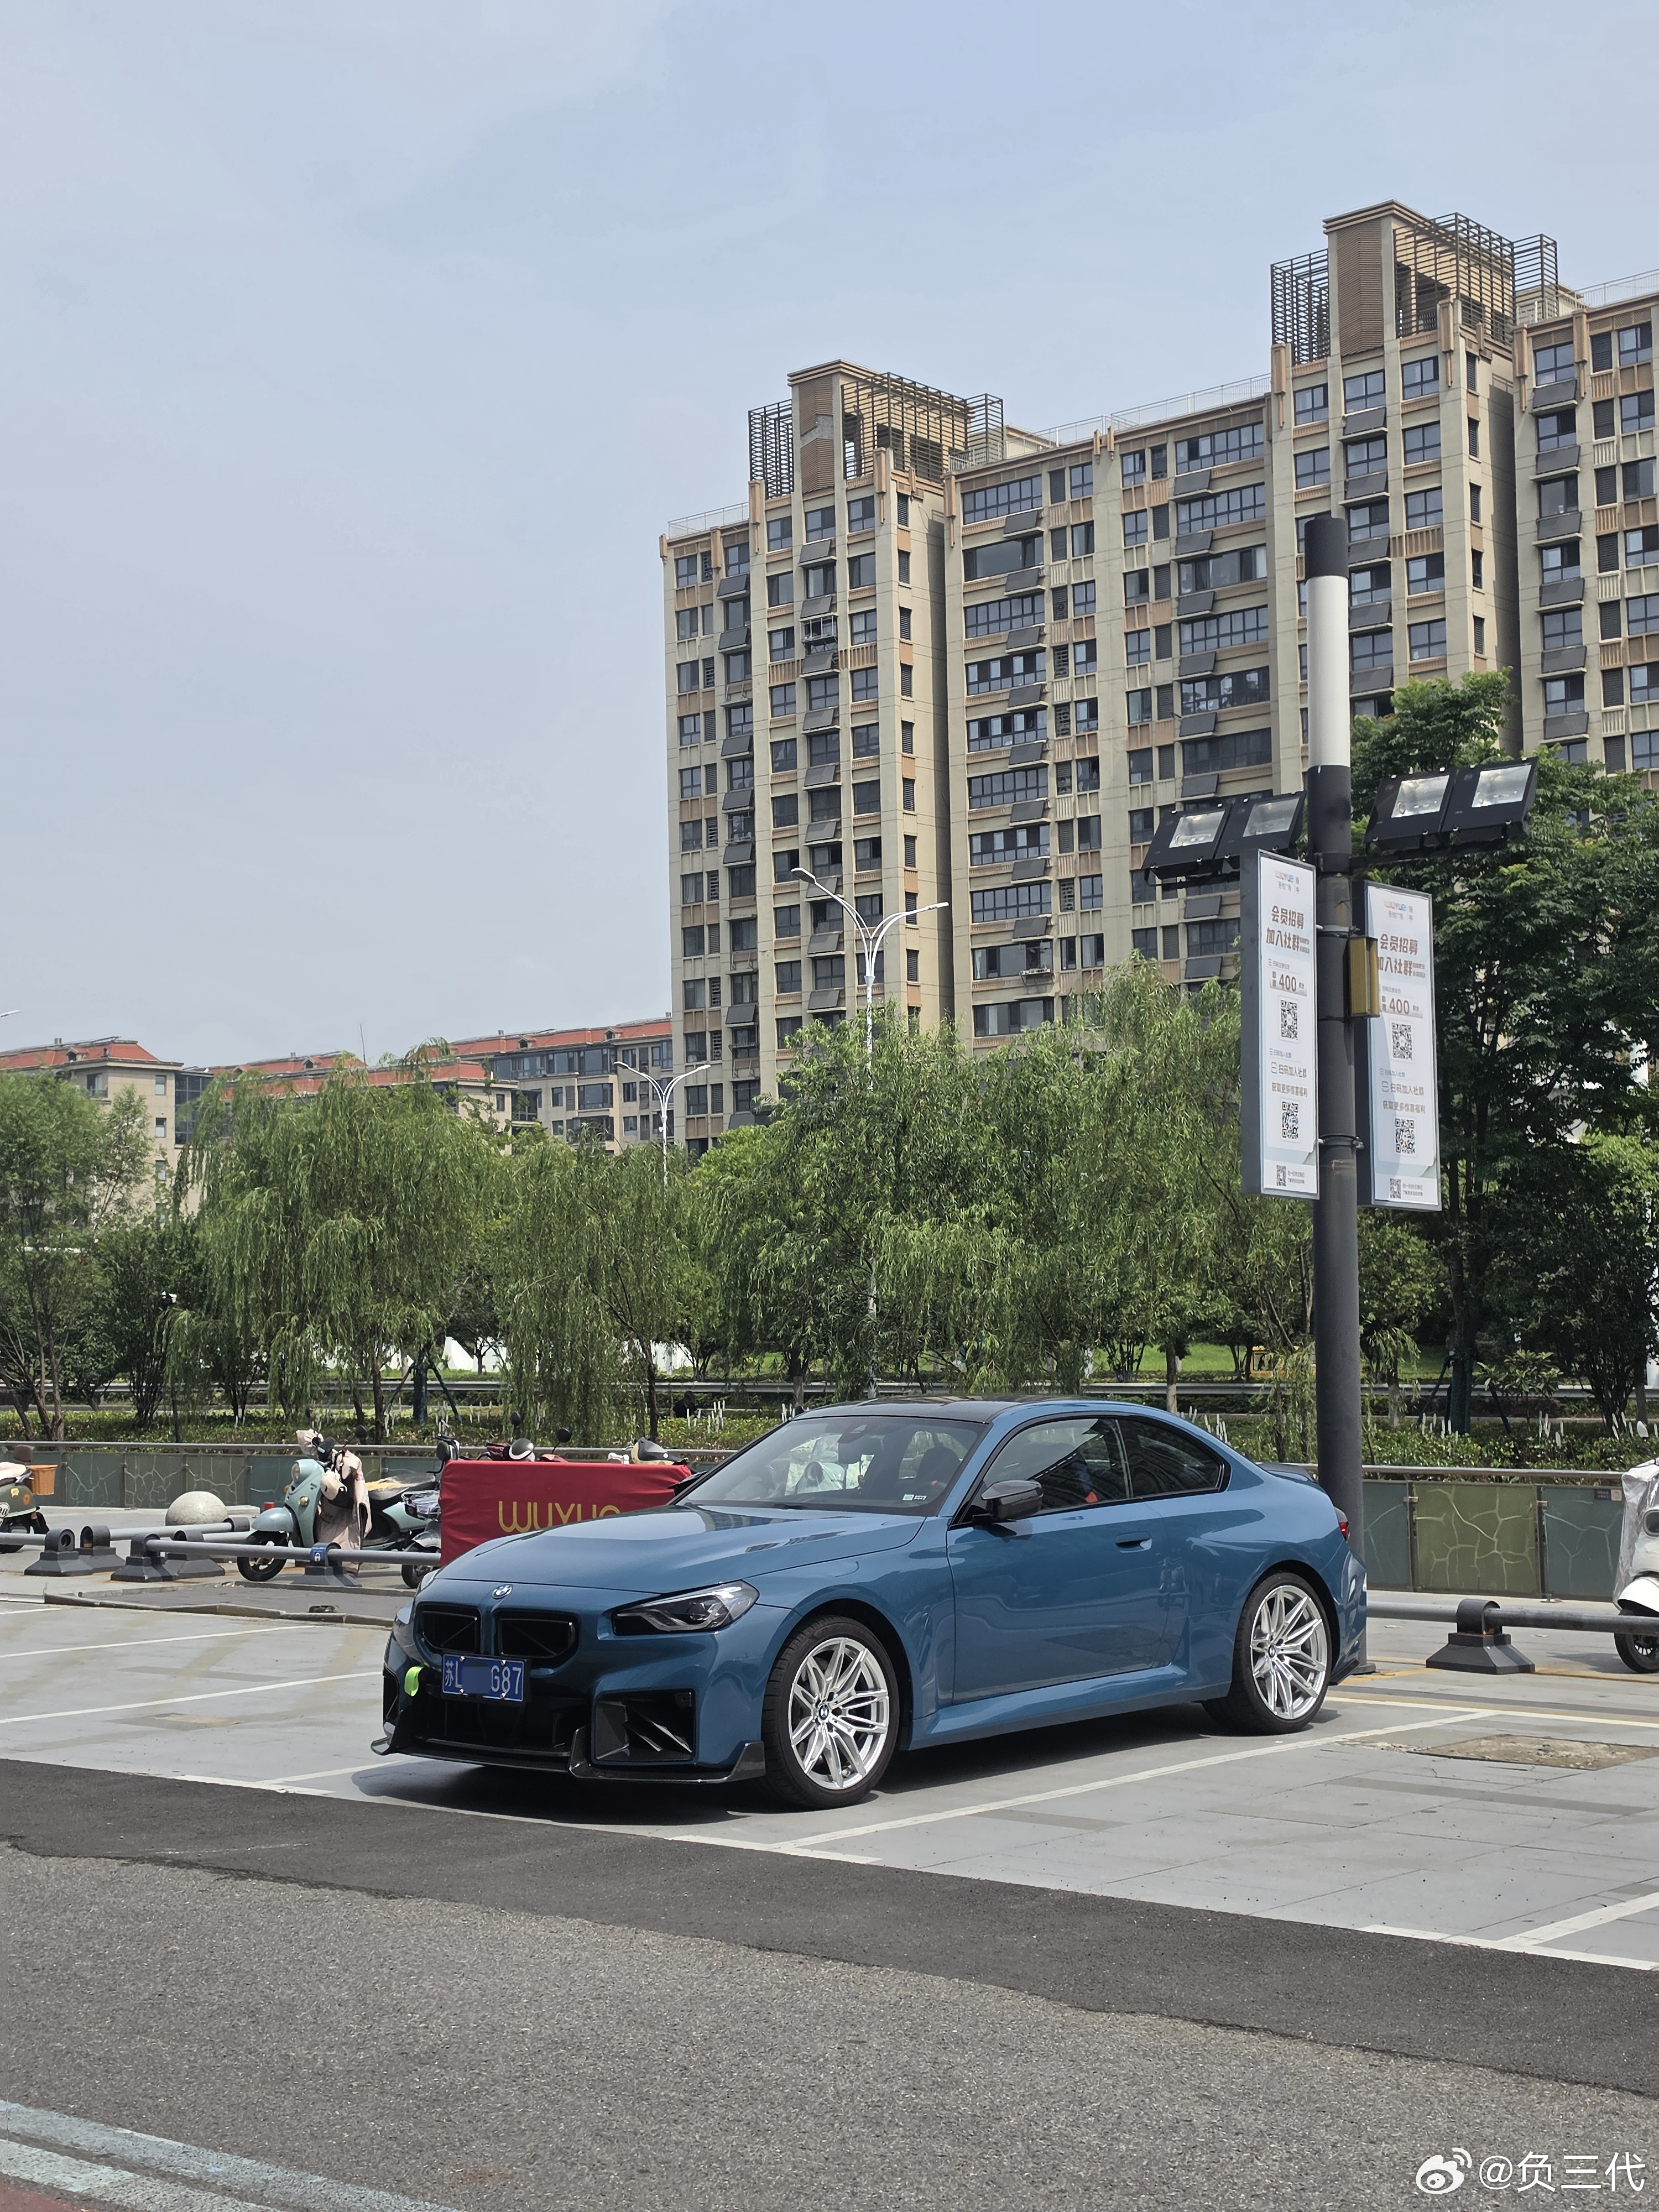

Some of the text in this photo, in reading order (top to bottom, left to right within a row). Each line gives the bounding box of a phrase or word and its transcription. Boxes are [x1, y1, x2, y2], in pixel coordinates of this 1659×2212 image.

[1271, 905, 1304, 930] 会员招募
[1266, 927, 1300, 952] 加入社群
[1380, 933, 1418, 956] 会员招募
[1279, 974, 1297, 992] 400
[1389, 998, 1410, 1015] 400
[1279, 1064, 1307, 1079] 扫码加入社群
[1390, 1083, 1424, 1096] 扫码加入社群
[445, 1660, 521, 1695] 苏LG87
